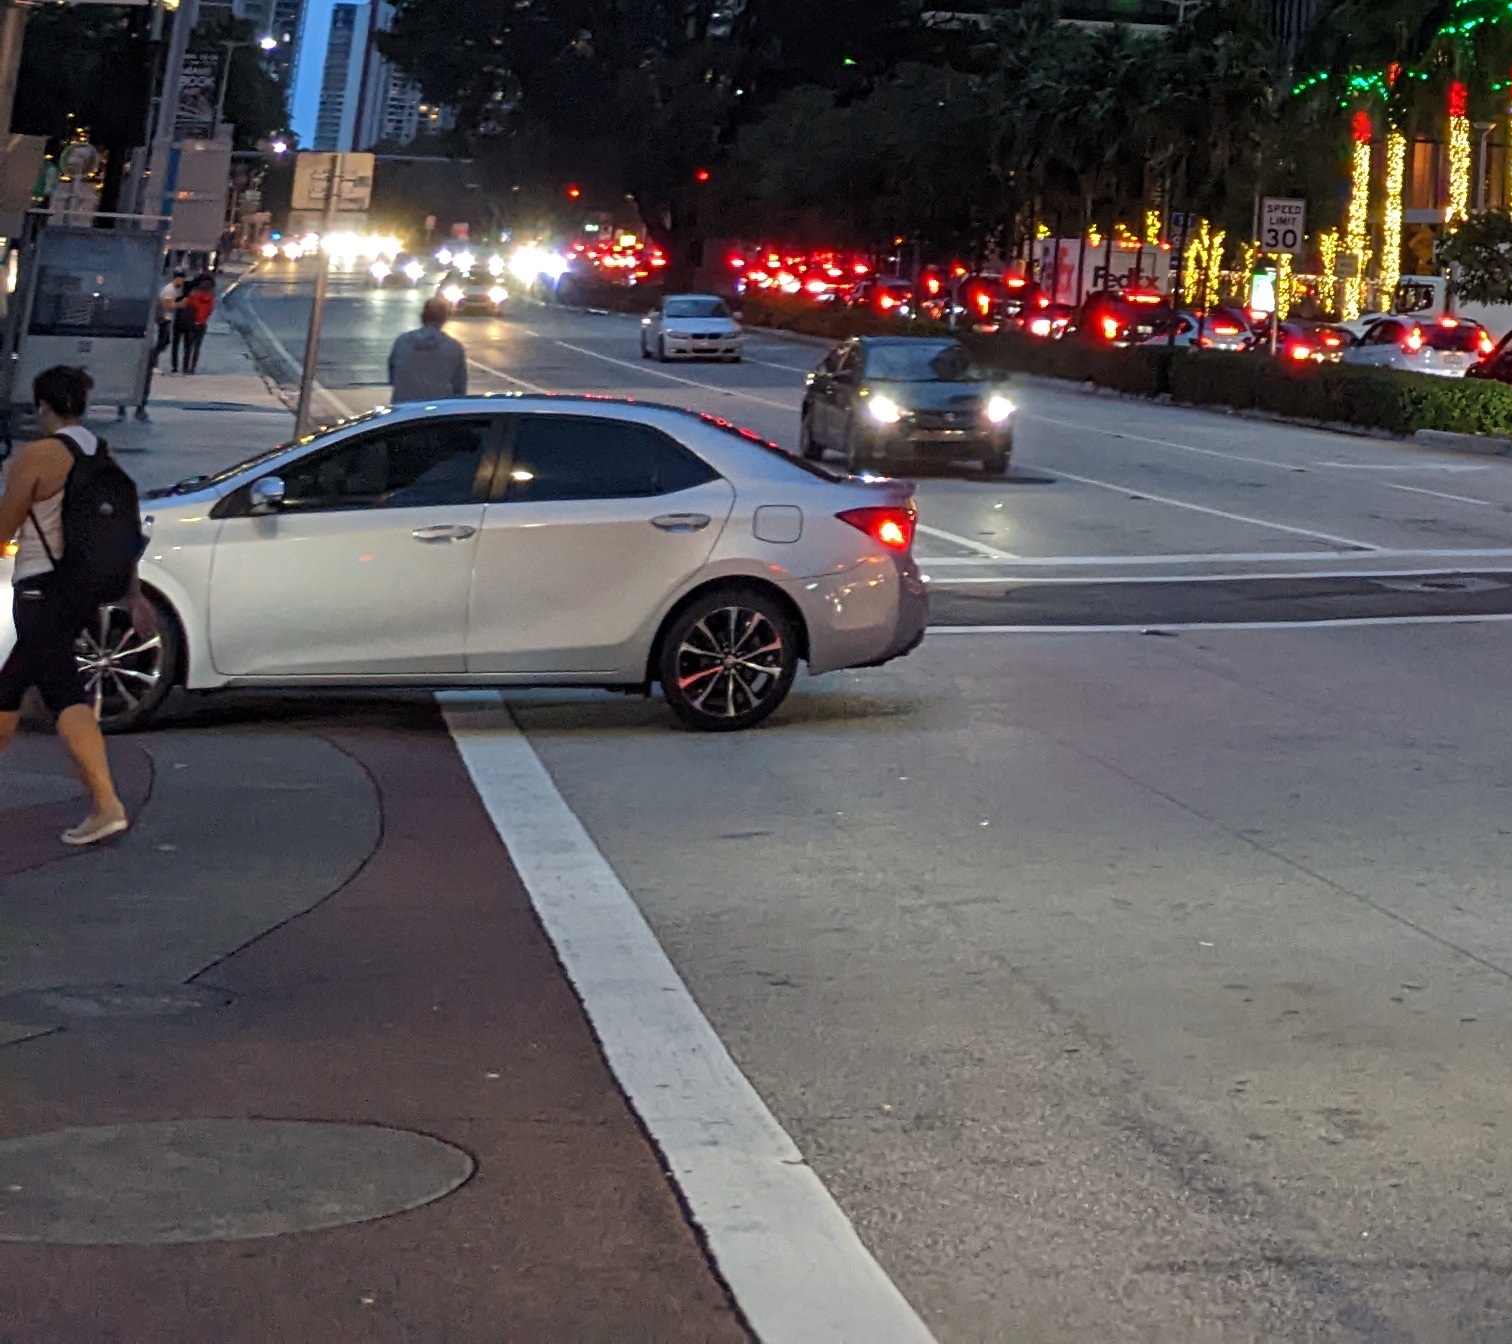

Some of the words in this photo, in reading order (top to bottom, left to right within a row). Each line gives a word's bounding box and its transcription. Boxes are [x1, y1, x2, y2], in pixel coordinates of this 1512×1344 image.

[1266, 204, 1301, 215] SPEED
[1269, 217, 1297, 226] LIMIT
[1264, 228, 1297, 249] 30
